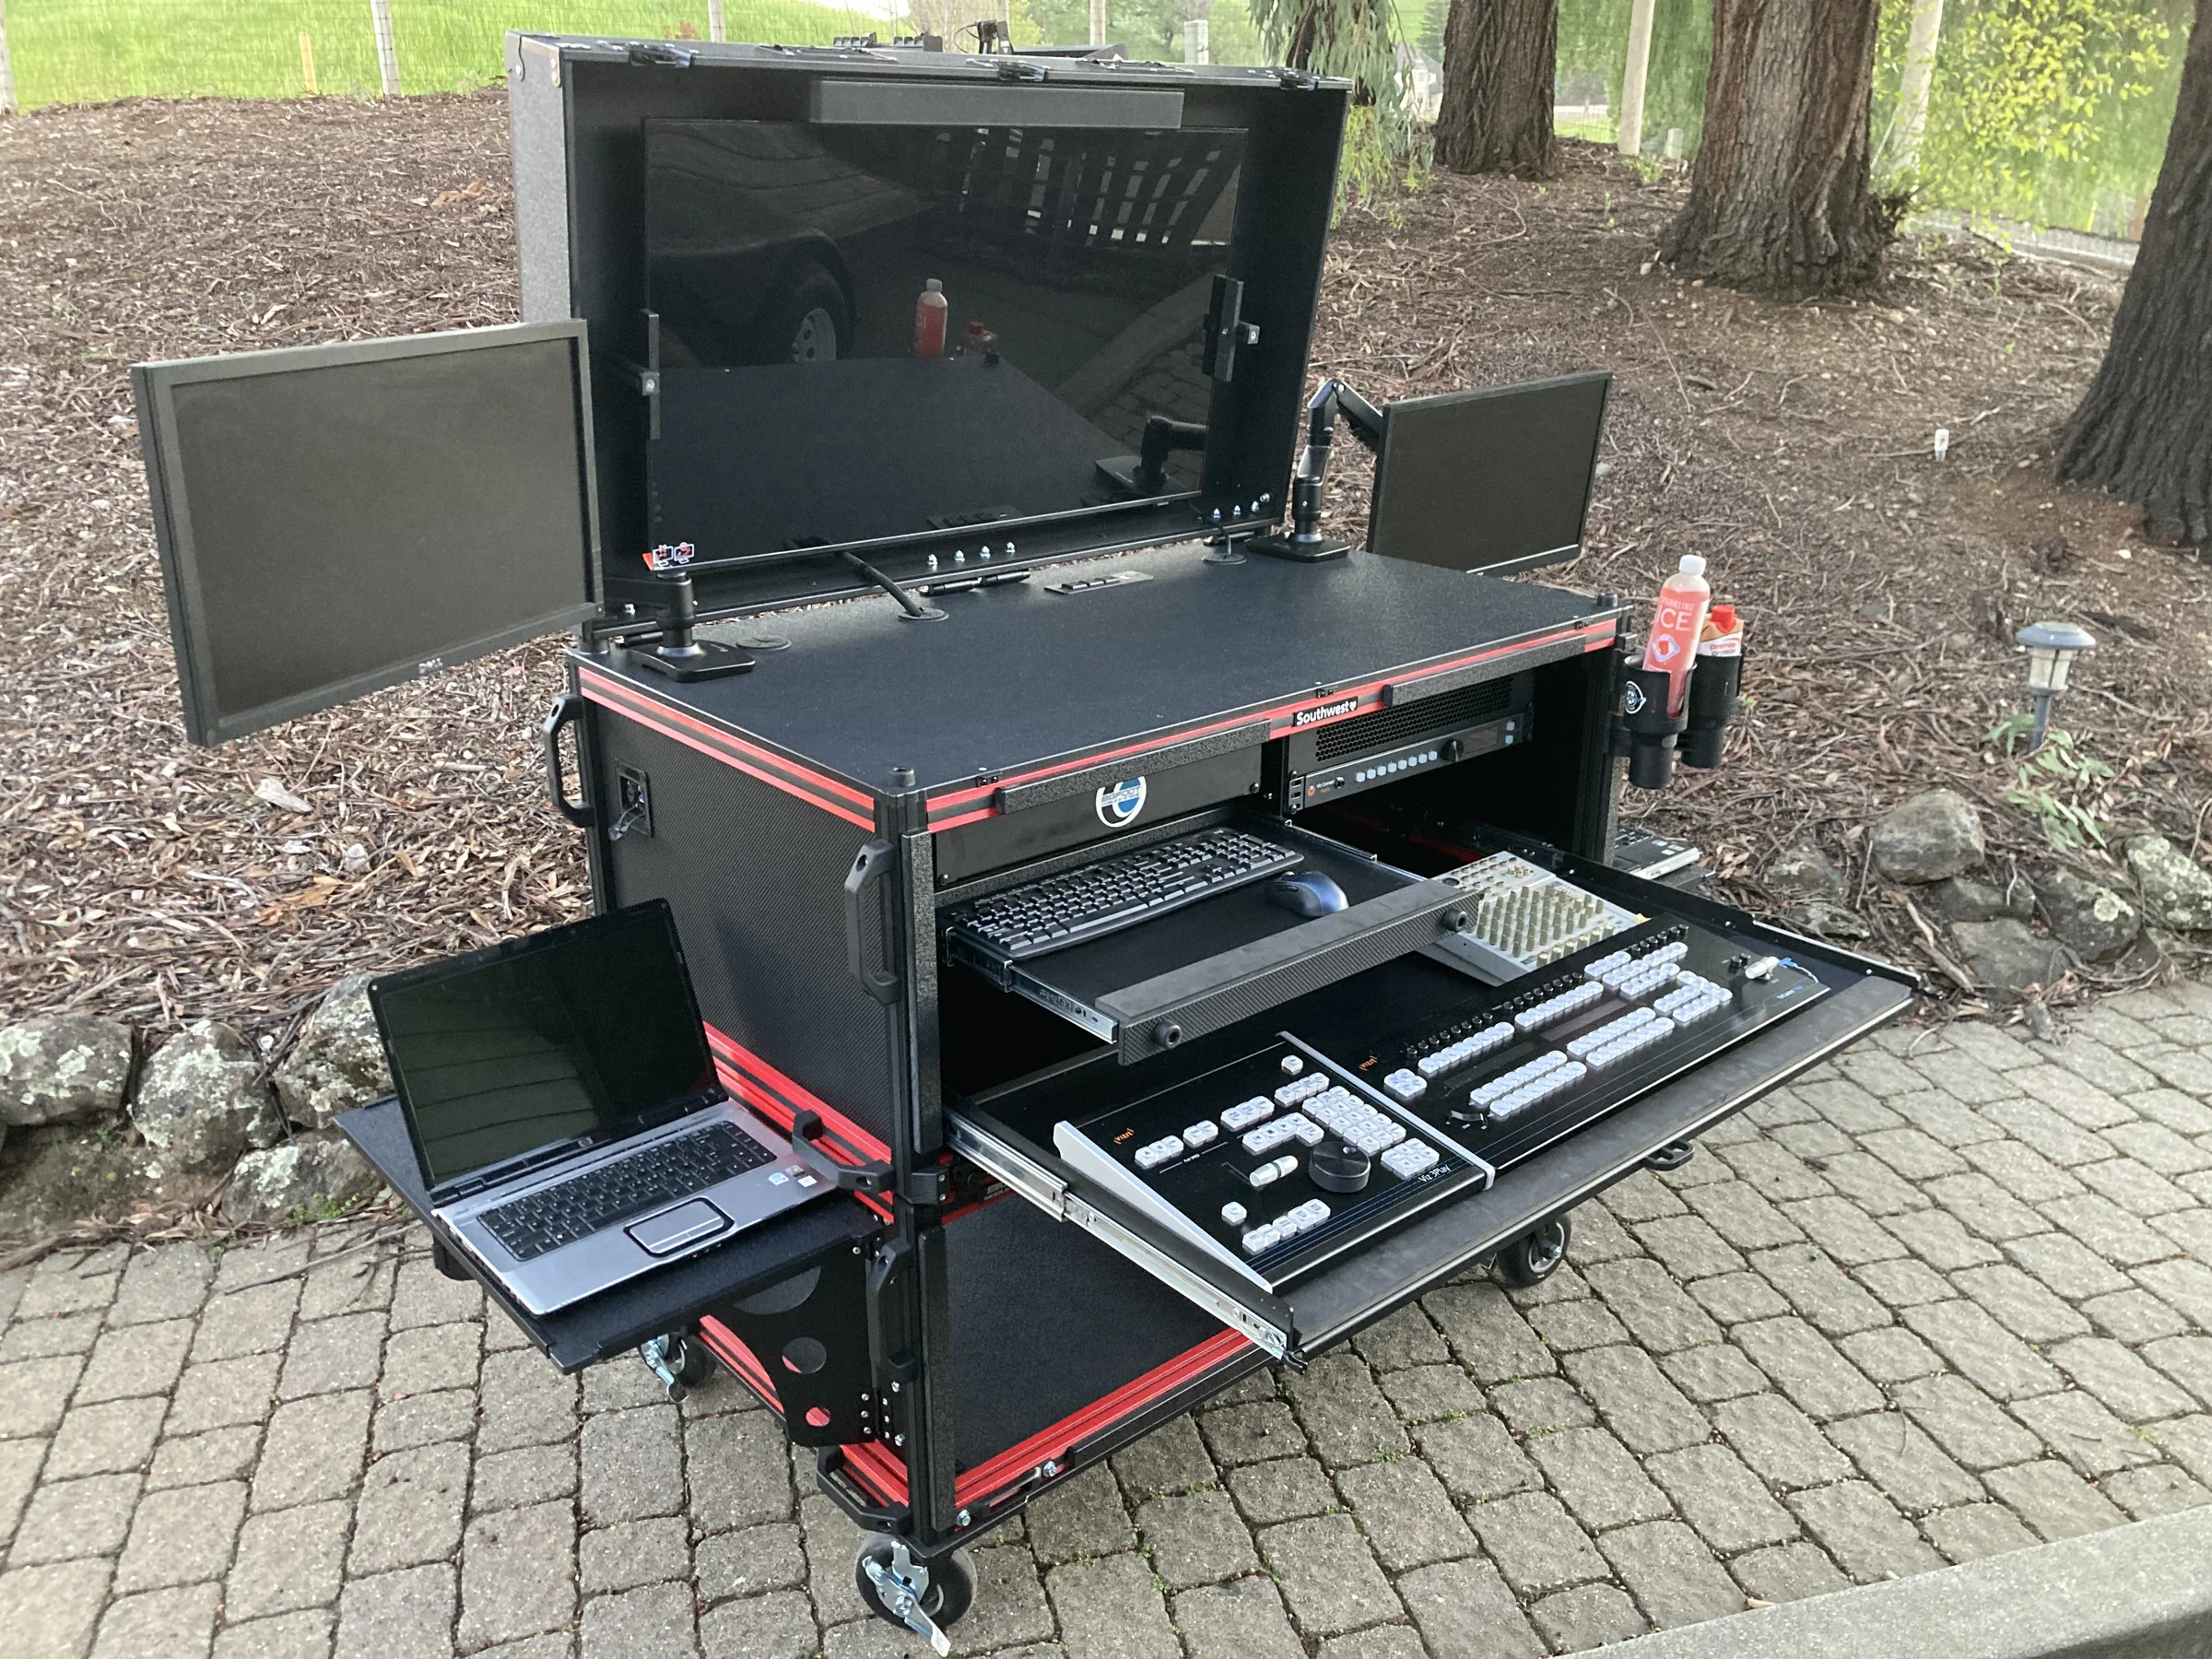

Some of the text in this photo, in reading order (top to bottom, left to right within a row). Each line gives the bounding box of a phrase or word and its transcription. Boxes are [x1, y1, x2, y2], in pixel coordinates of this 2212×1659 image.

[1655, 605, 1692, 631] ICE
[1296, 700, 1349, 726] Southwest
[1101, 787, 1139, 803] BIGFOOT
[1418, 1164, 1452, 1182] Viz 3Play
